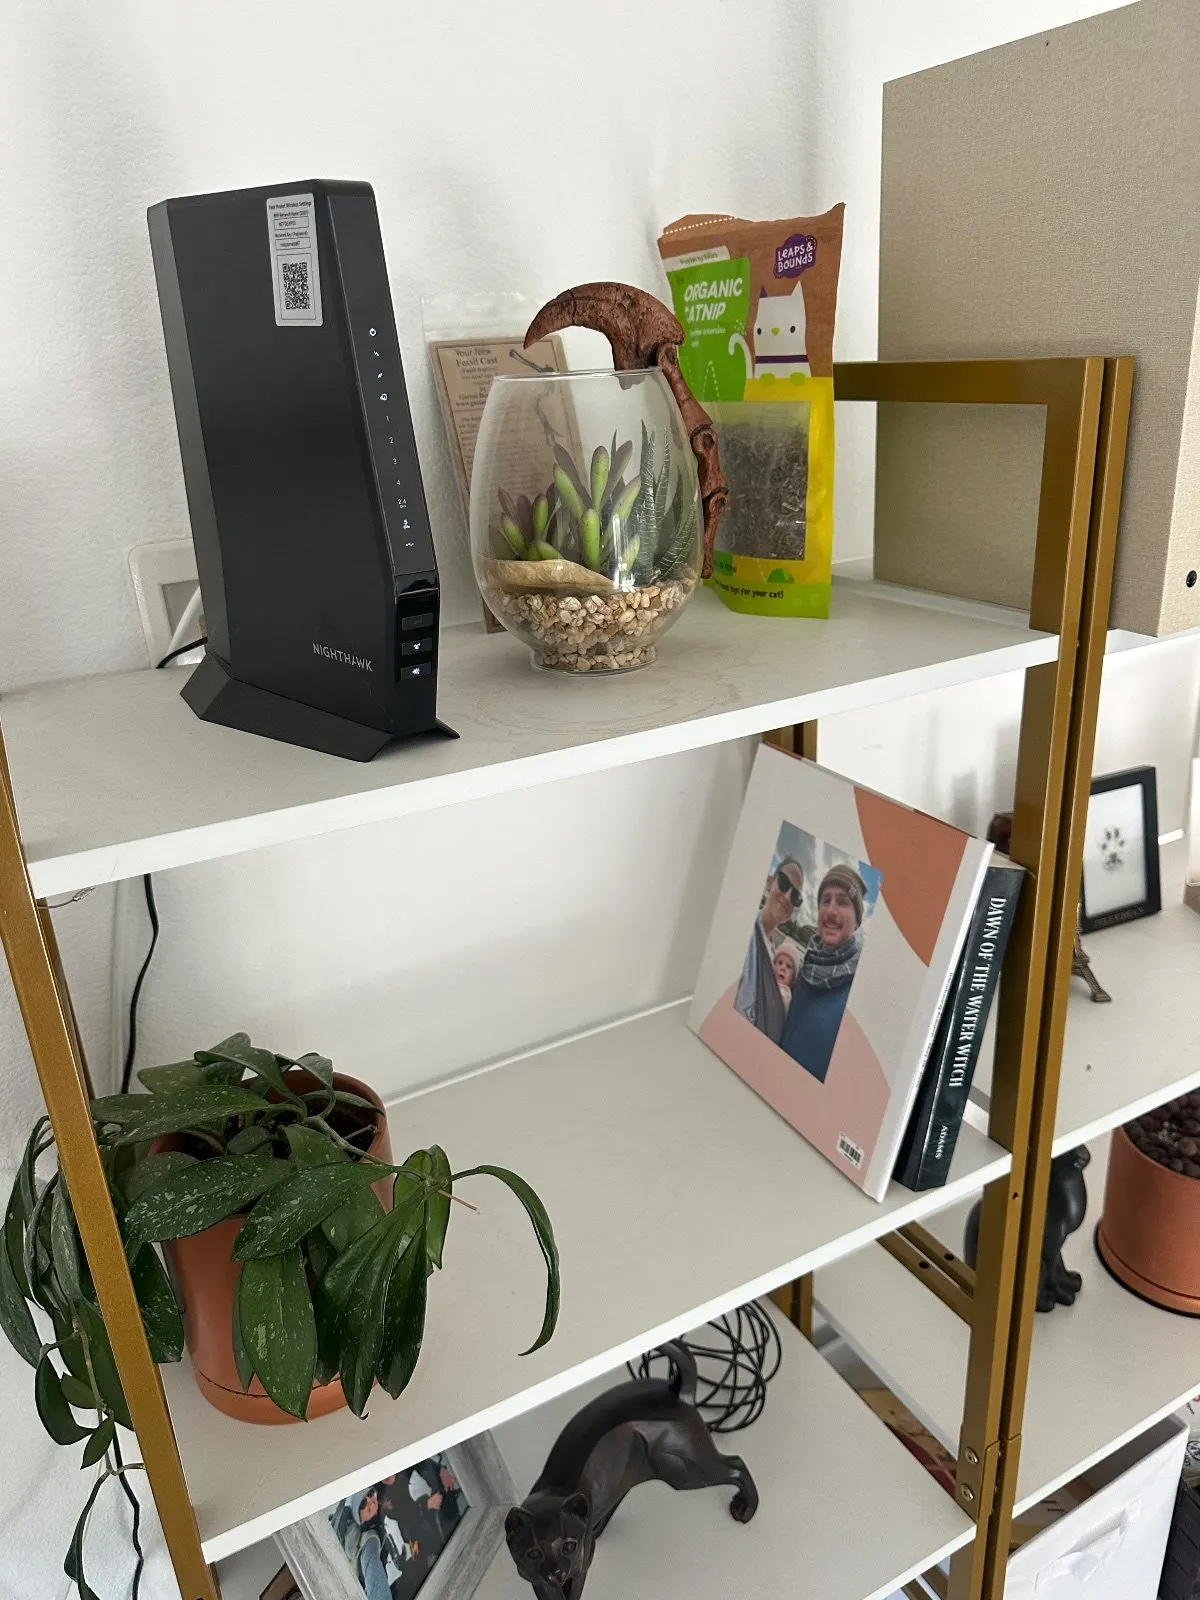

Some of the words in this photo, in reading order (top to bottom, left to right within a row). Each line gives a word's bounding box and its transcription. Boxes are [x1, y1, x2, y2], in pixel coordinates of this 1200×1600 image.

[806, 241, 814, 252] &
[684, 277, 743, 302] ORGANIC
[388, 436, 394, 444] 2
[752, 590, 767, 599] your
[769, 590, 784, 600] cat!
[312, 642, 374, 672] NIGHTHAWK
[983, 897, 1007, 940] DAWN
[978, 942, 996, 961] OF
[970, 963, 991, 992] THE
[958, 995, 984, 1041] WATER
[948, 1043, 972, 1088] WITCH
[935, 1124, 948, 1160] ADAMS
